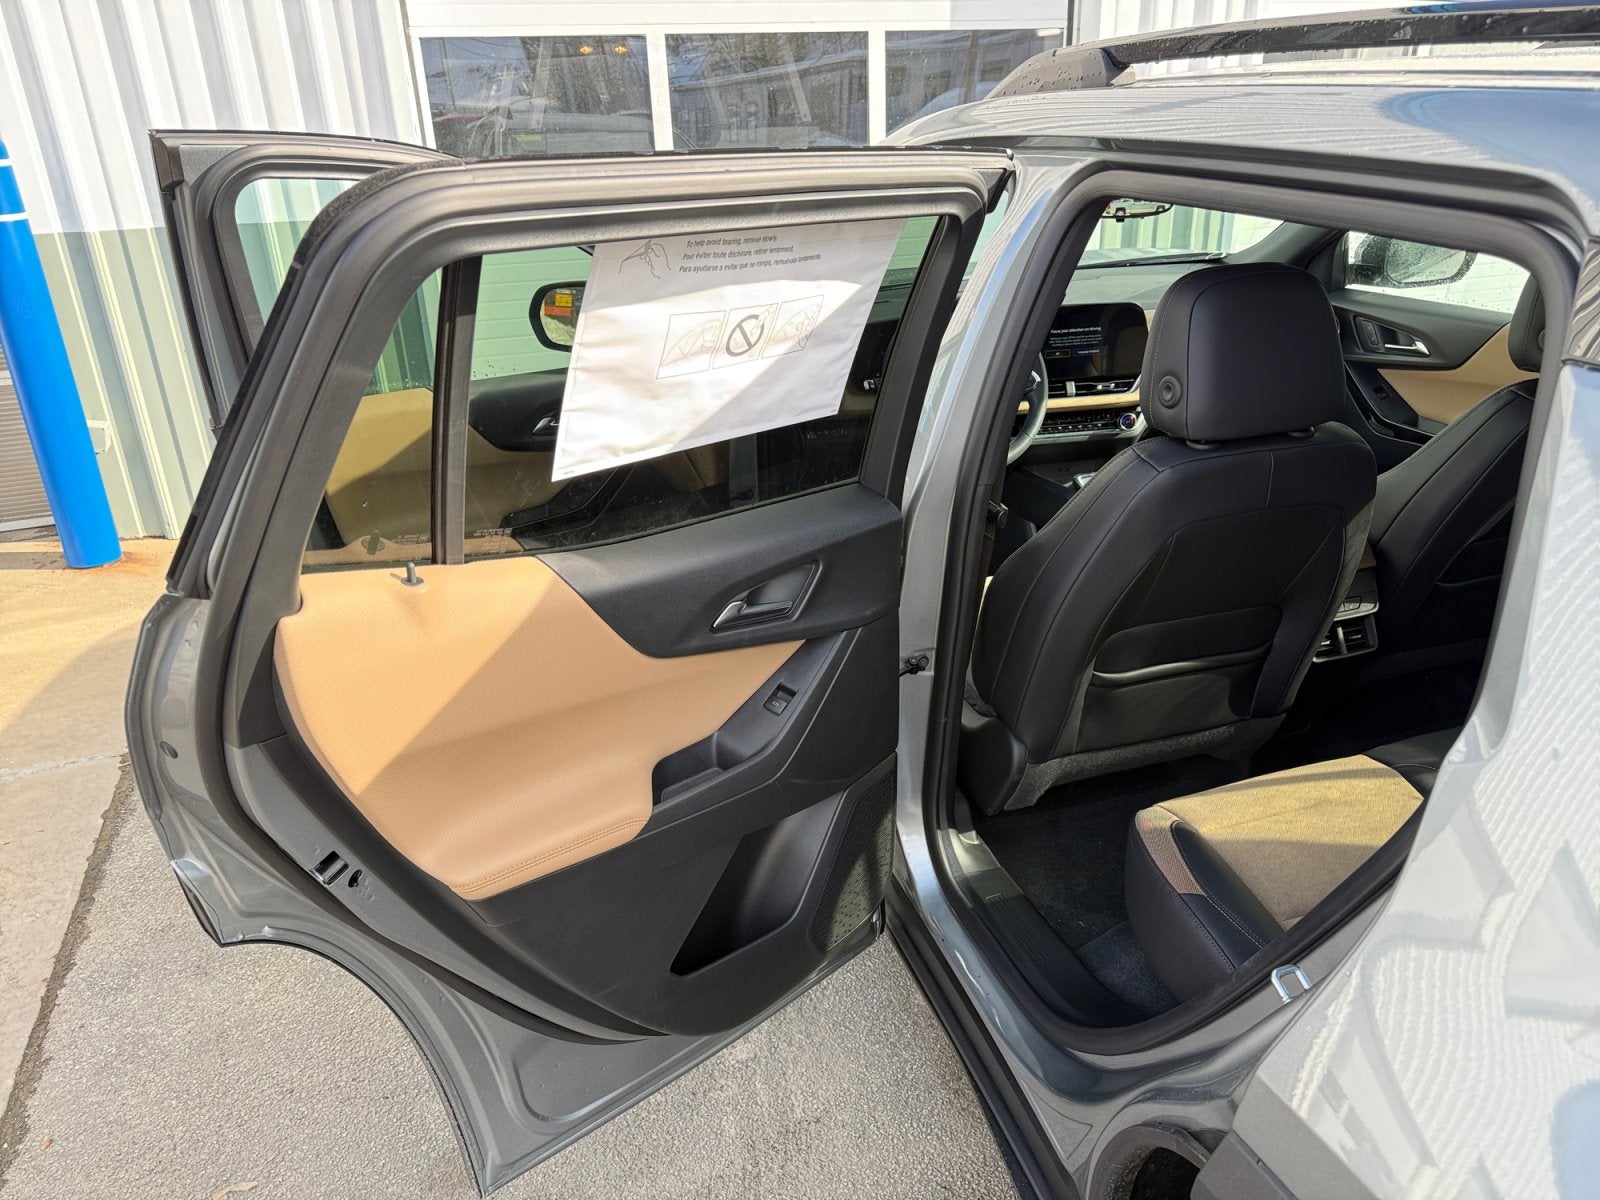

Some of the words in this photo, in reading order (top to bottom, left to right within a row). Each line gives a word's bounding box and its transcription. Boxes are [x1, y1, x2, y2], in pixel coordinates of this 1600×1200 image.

[687, 240, 693, 248] To
[694, 239, 705, 247] help
[706, 238, 721, 246] avoid
[722, 238, 741, 246] tearing,
[695, 251, 711, 259] éviter
[679, 265, 691, 273] Para
[693, 264, 718, 274] ayudarse
[724, 263, 738, 271] evitar
